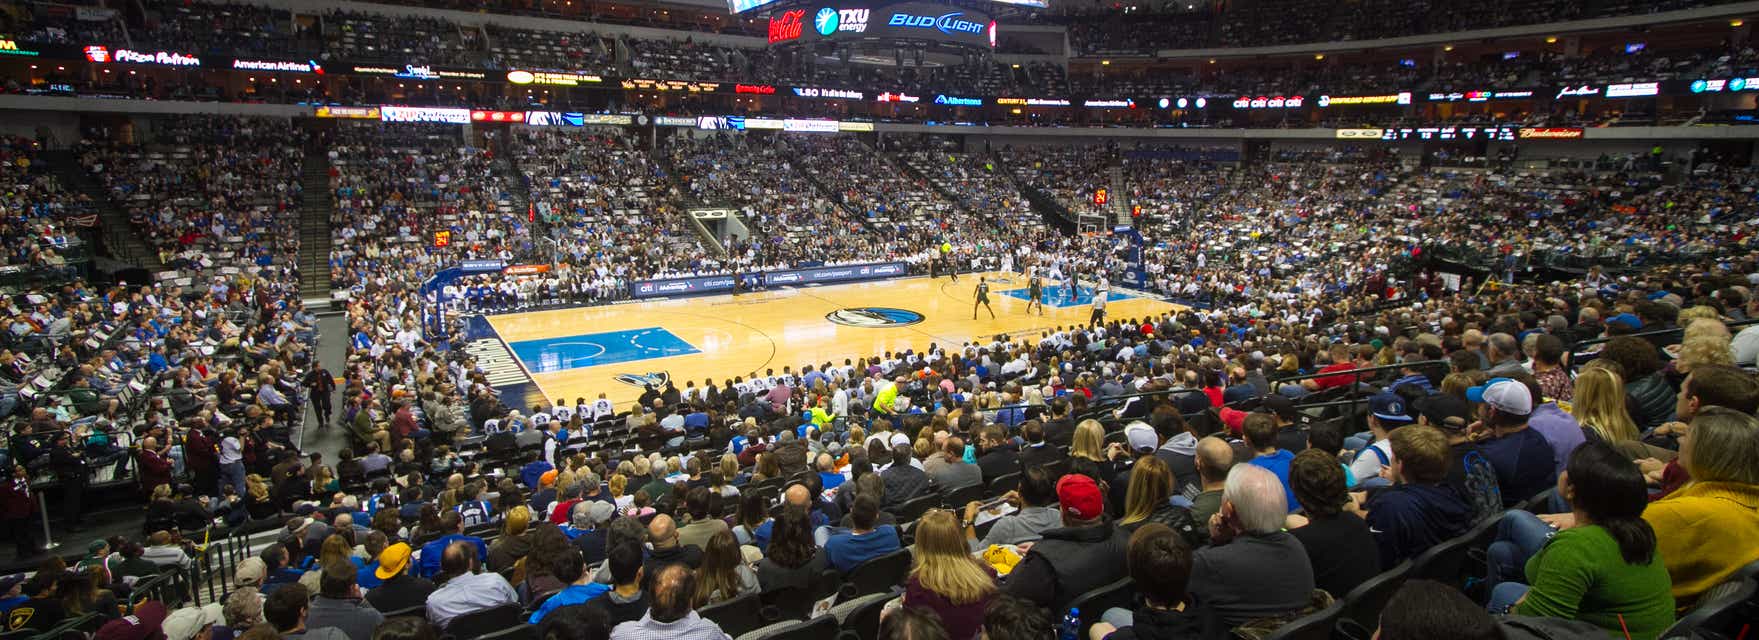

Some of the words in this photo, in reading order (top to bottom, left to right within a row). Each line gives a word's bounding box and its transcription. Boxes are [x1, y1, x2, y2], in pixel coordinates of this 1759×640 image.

[839, 9, 870, 23] TXU
[889, 14, 936, 27] BUD
[839, 24, 867, 32] energy
[944, 18, 984, 33] LIGHT
[234, 60, 277, 69] American
[278, 62, 311, 71] Airlines
[1519, 128, 1581, 138] Budweiser
